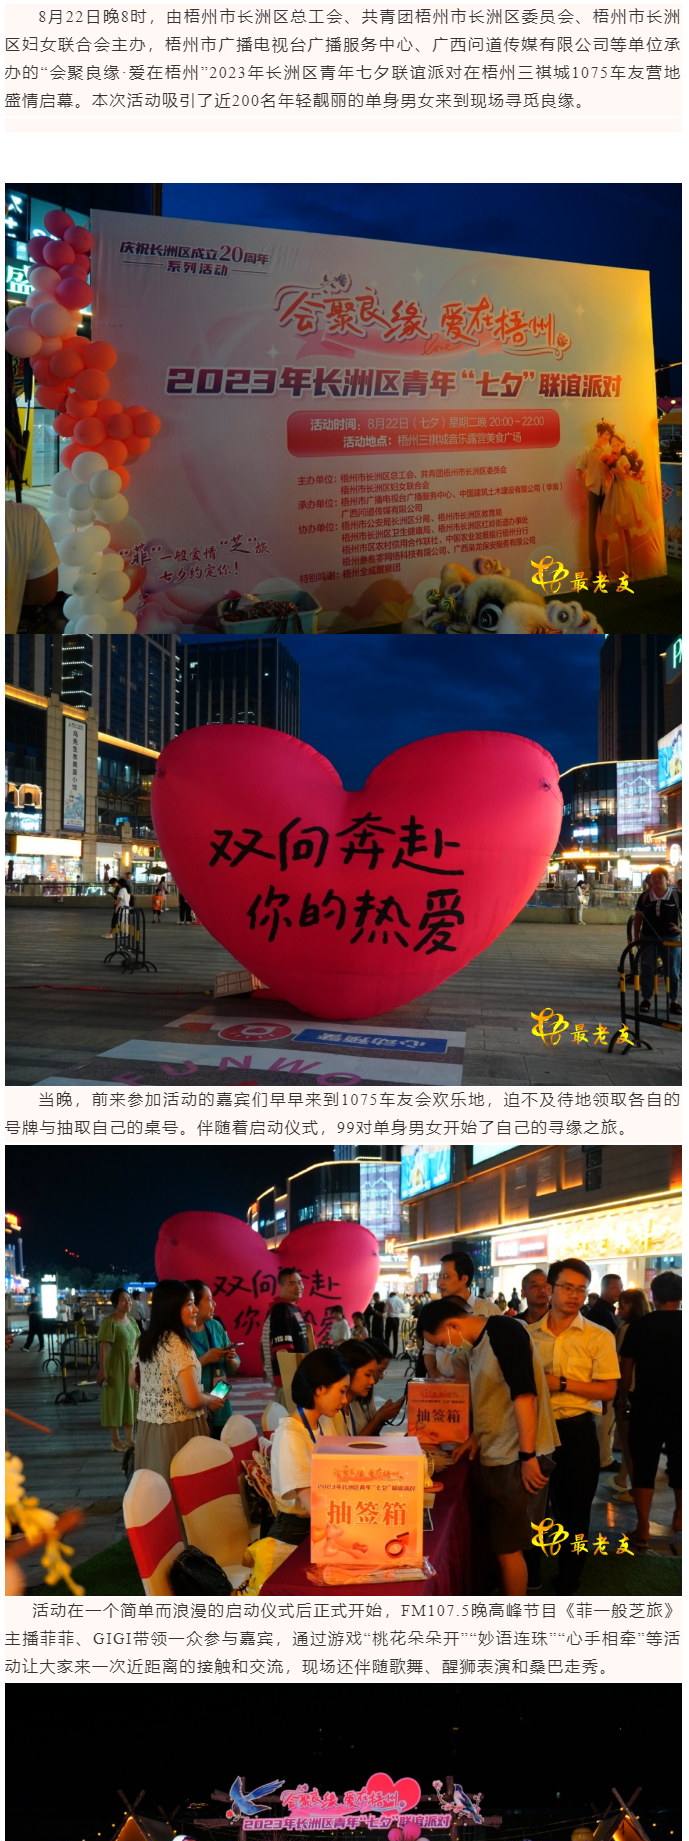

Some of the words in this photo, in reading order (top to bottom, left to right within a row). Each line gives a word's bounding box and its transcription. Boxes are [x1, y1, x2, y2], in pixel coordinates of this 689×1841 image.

[120, 240, 270, 265] 庆祝长洲区成立20周年
[166, 260, 229, 277] 系列活动
[278, 286, 429, 342] 会聚良缘
[440, 295, 556, 347] 爱在梧州
[165, 366, 623, 399] 2023年长洲区青年“七夕”联谊派对
[340, 480, 430, 496] 梧州市长洲区妇女联合会
[341, 503, 423, 519] 广西问道传媒有限公司
[208, 811, 465, 877] 双向奔赴
[246, 884, 465, 956] 你的热爱
[212, 1267, 342, 1300] 双向赴
[416, 1408, 461, 1423] 抽签箱
[326, 1499, 408, 1527] 抽签箱
